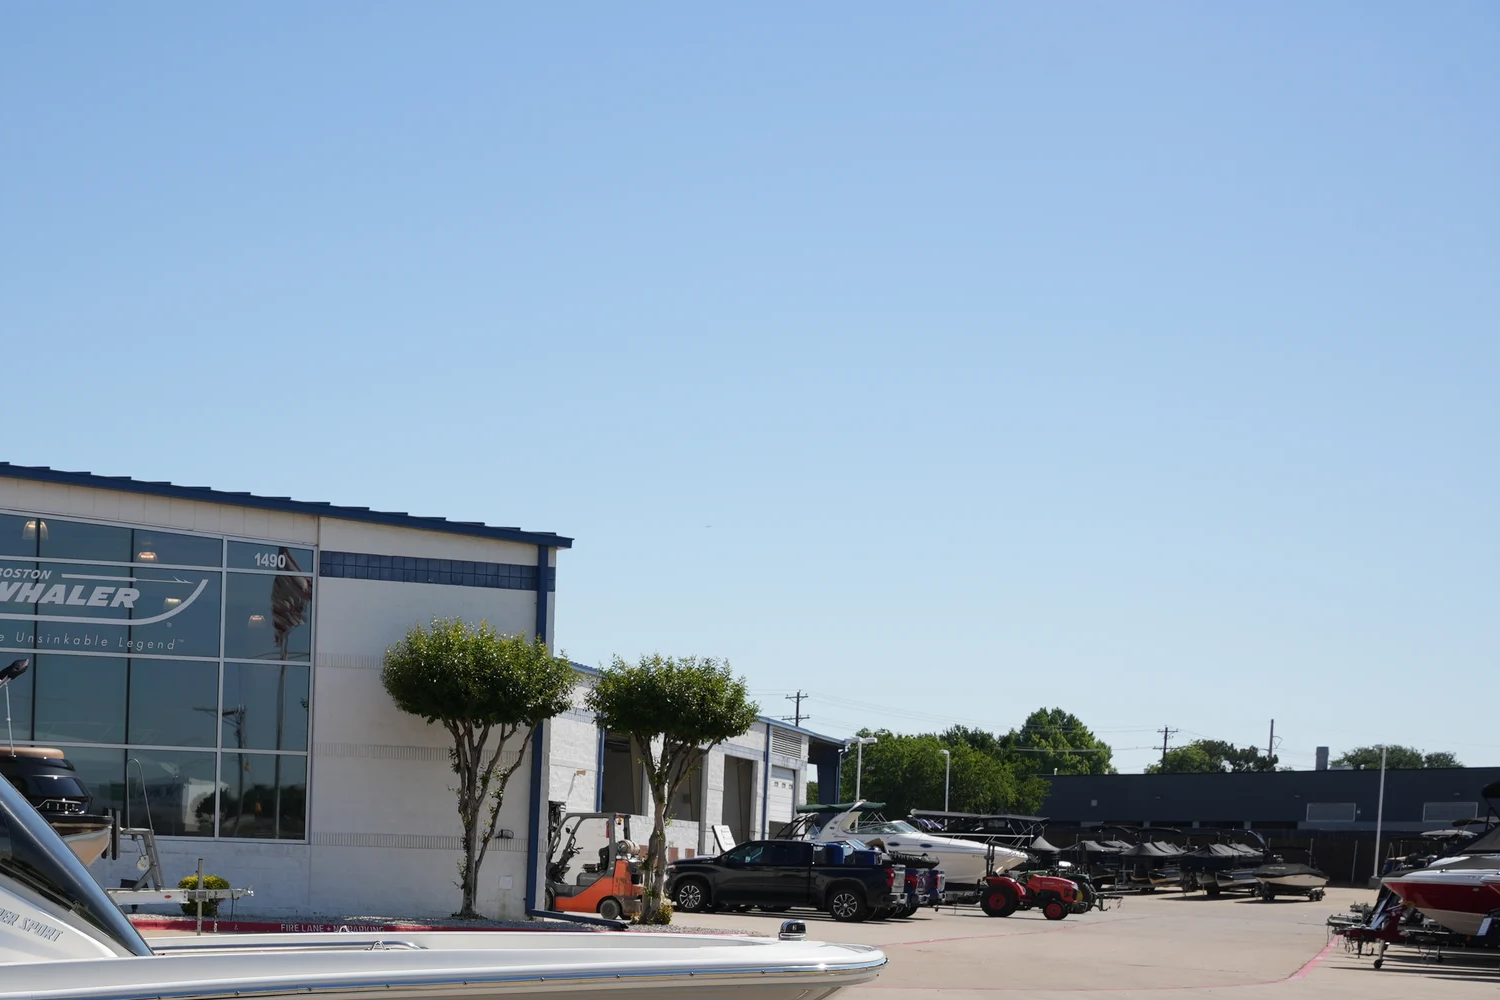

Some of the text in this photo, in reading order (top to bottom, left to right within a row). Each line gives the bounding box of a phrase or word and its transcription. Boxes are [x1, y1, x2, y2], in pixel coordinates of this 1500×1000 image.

[254, 552, 286, 568] 1490
[15, 632, 108, 647] Unsinkable
[18, 917, 64, 942] SPORT
[280, 923, 299, 932] FIRE
[301, 924, 324, 932] LANE
